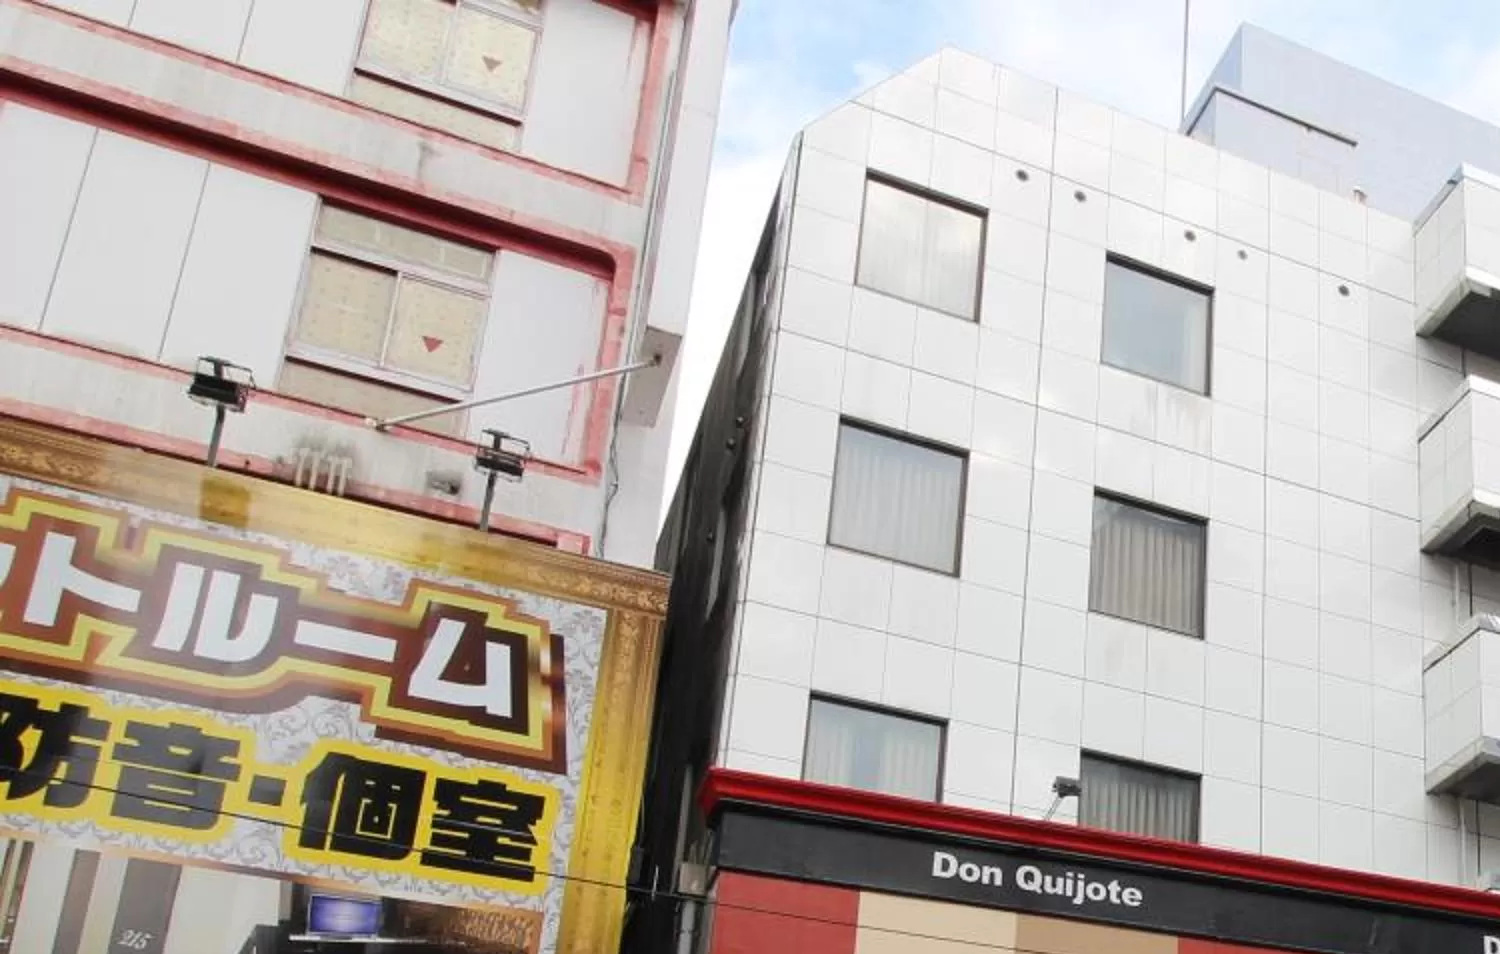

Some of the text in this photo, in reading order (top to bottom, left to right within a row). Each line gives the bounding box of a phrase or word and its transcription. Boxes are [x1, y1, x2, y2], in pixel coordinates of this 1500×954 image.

[0, 530, 512, 718] トルーム
[932, 851, 1143, 908] Don Quijote
